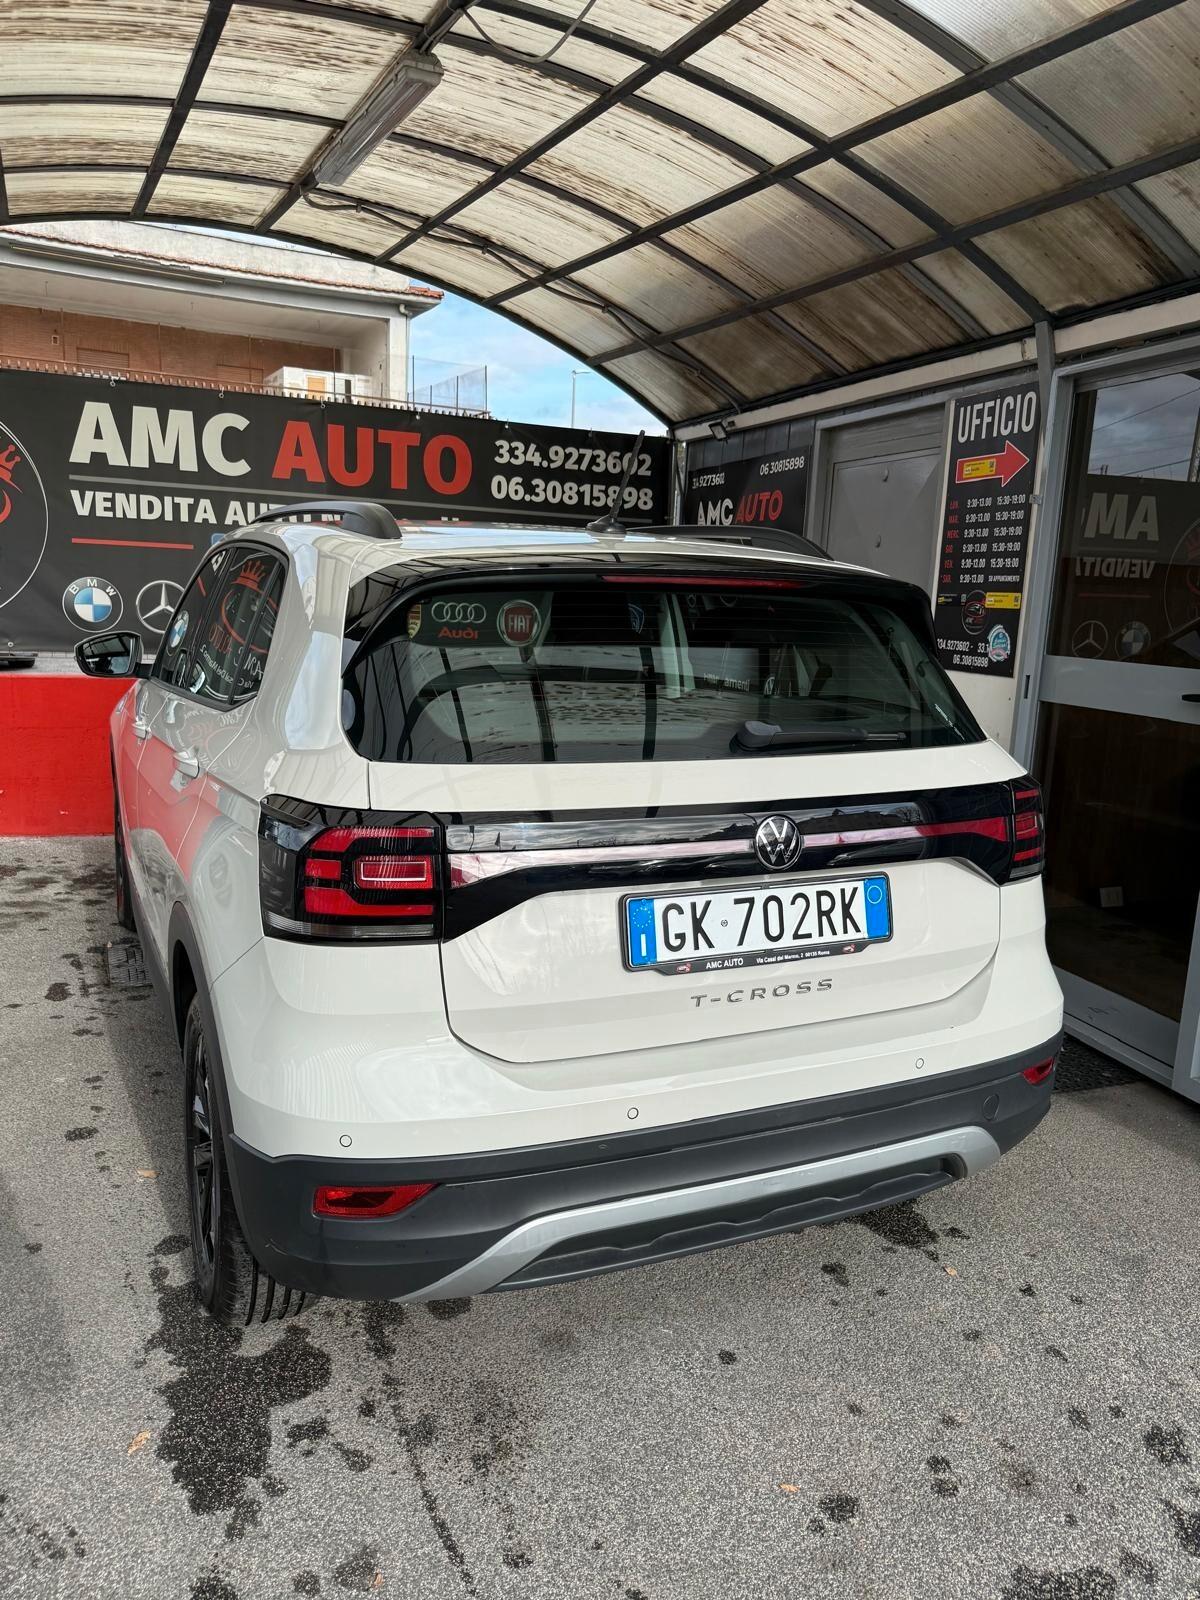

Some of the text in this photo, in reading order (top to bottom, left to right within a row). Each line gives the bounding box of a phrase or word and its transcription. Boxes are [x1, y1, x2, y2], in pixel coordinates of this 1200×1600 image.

[957, 391, 1037, 444] UFFICIO
[68, 400, 473, 495] AMC AUTO
[494, 439, 652, 476] 334.9273602
[70, 489, 217, 525] VENDITA
[490, 475, 653, 511] 06.30815898
[697, 490, 783, 526] AMC AUTO
[69, 578, 117, 597] BMW
[438, 627, 480, 640] Audi
[508, 613, 532, 634] FIAT
[662, 900, 716, 952] GK
[733, 886, 862, 947] 702RK
[706, 958, 744, 970] AMC AUTO
[691, 978, 833, 1008] T-CROSS
